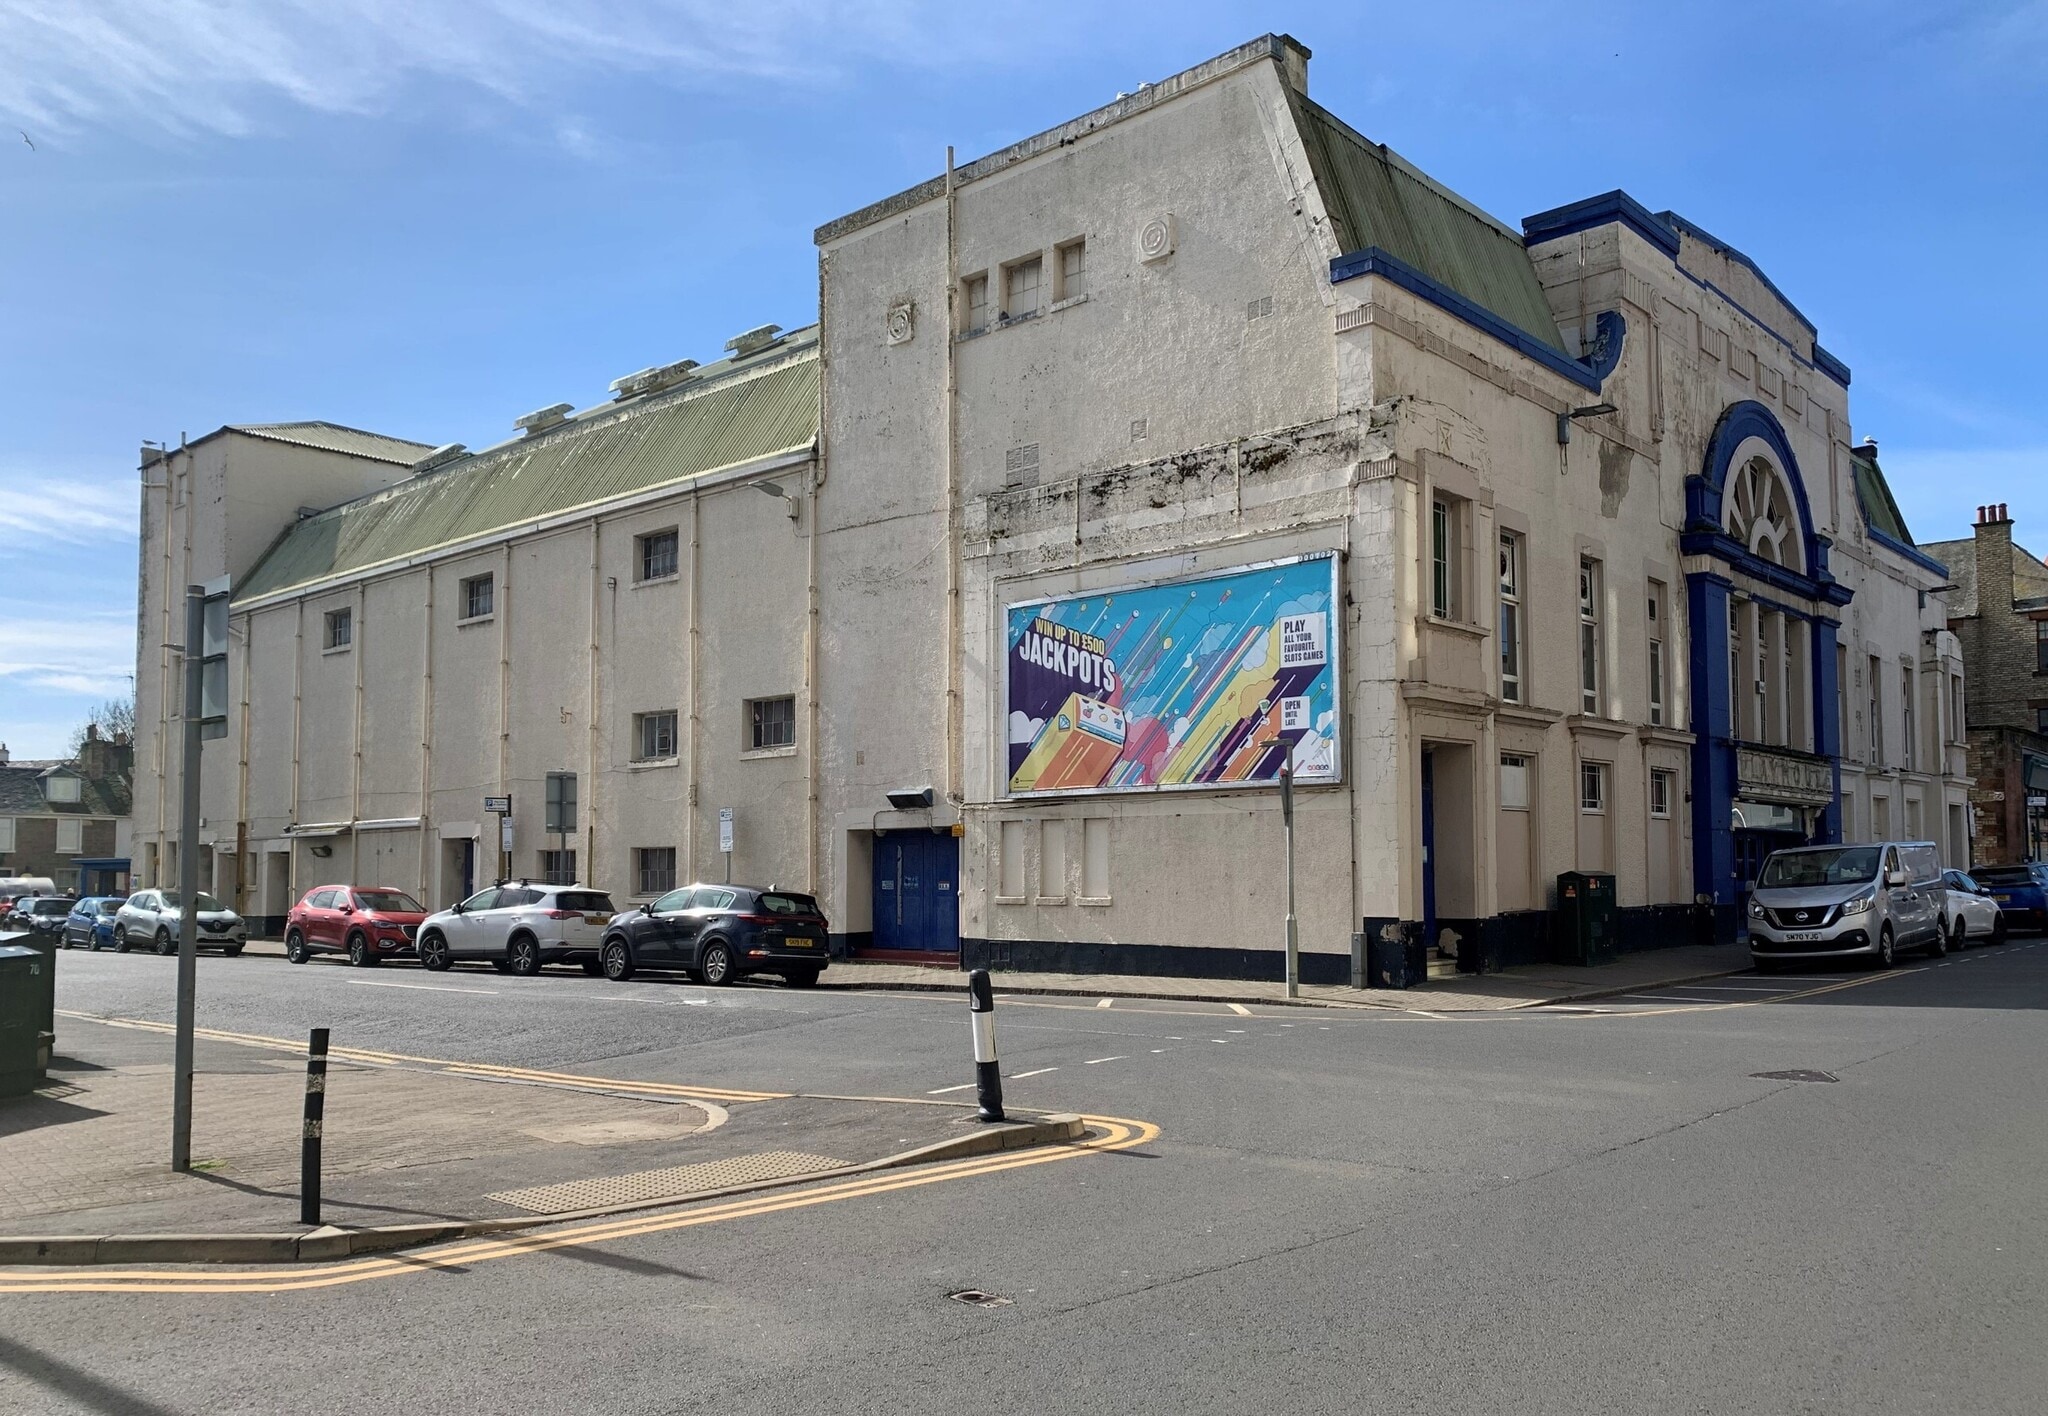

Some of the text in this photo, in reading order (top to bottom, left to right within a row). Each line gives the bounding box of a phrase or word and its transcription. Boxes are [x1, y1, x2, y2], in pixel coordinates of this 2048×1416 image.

[1284, 619, 1305, 634] PLAY
[1035, 617, 1105, 656] WIN UP TO £500
[1284, 632, 1312, 643] ALL YOUR
[1284, 641, 1315, 653] FAVOURITE
[1019, 630, 1116, 692] JACKPOTS
[1284, 650, 1324, 662] SLOTS GAMES
[1284, 700, 1301, 710] OPEN
[30, 963, 40, 975] 70
